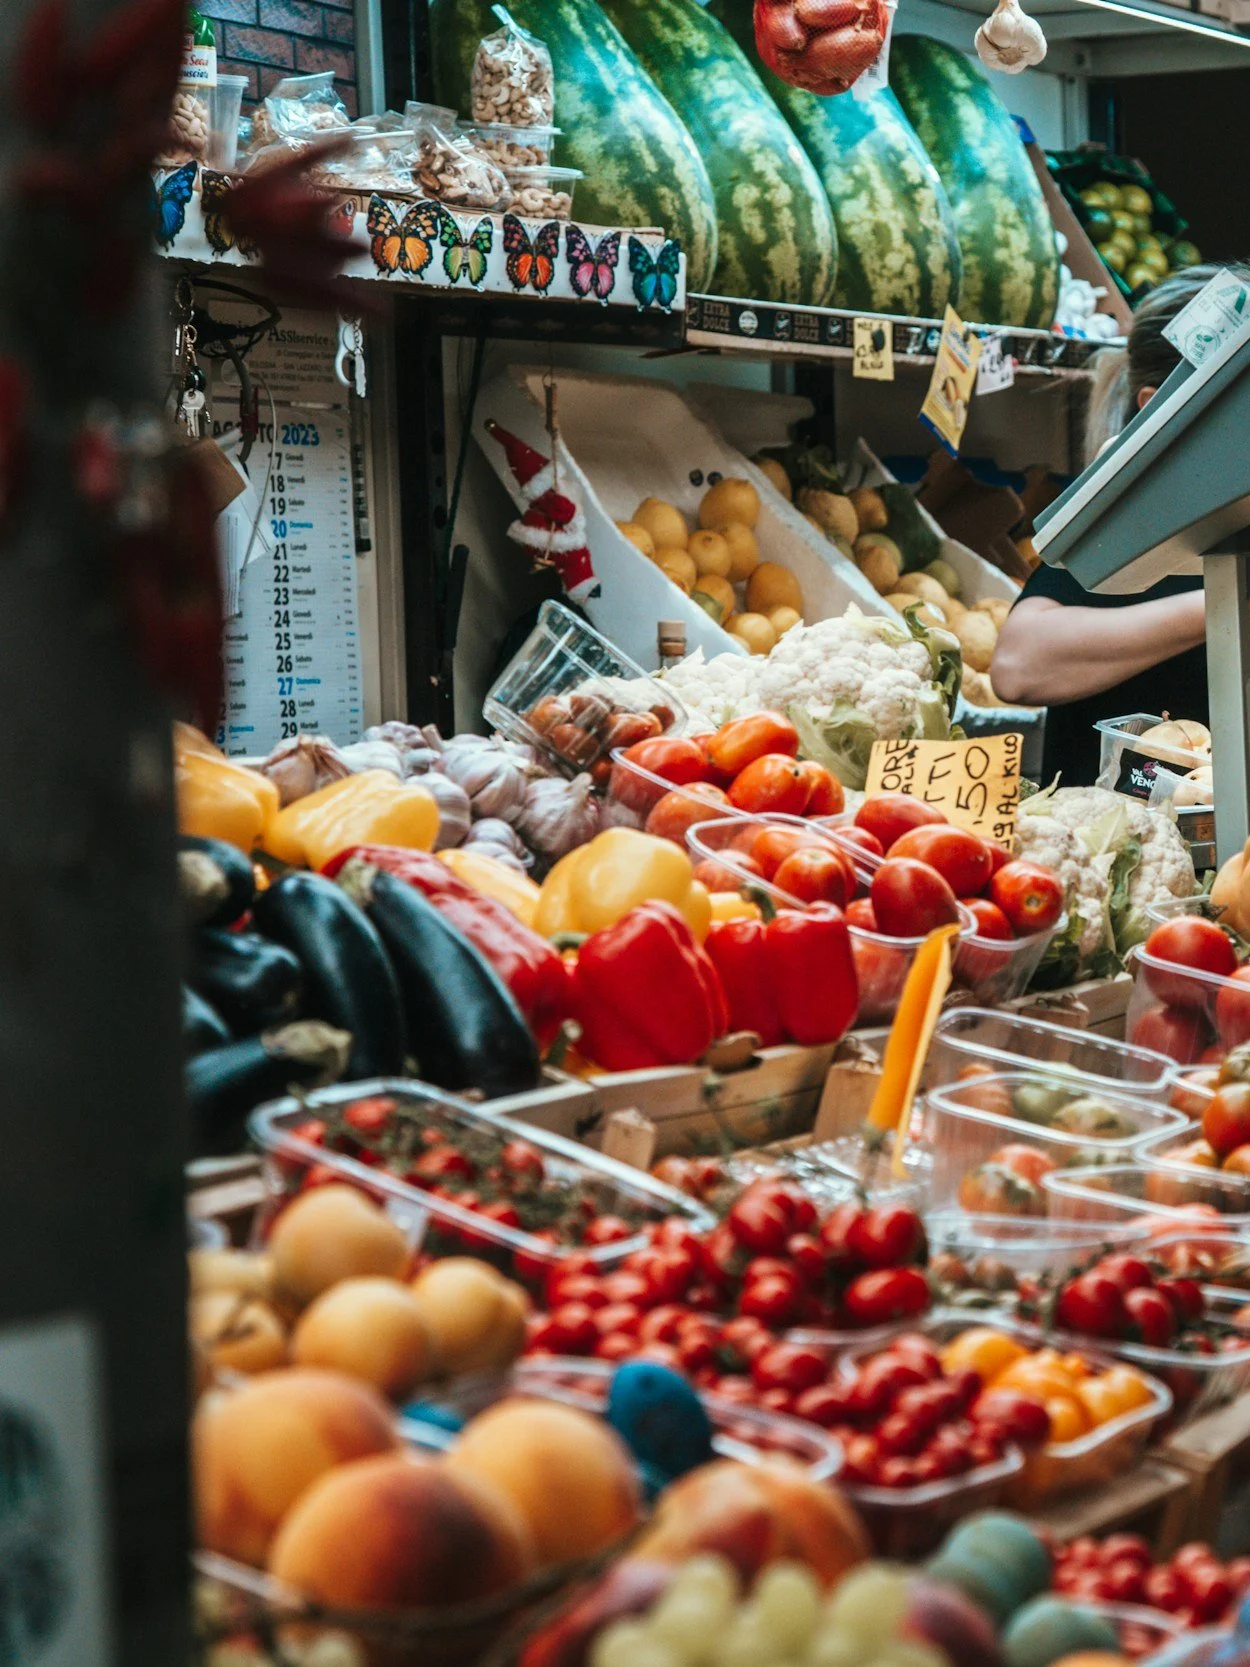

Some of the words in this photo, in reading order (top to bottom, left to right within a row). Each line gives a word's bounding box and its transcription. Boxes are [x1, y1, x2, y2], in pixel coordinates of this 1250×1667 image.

[281, 422, 320, 446] 2023
[270, 474, 285, 493] 18
[270, 497, 286, 516] 19
[270, 519, 288, 539] 20
[273, 565, 289, 583] 22
[273, 587, 290, 605] 23
[274, 610, 291, 628] 24
[275, 632, 292, 651] 25
[276, 655, 293, 674] 26
[277, 676, 294, 696] 27
[280, 699, 297, 719] 28
[281, 721, 298, 740] 29
[1130, 774, 1157, 790] VENO
[1131, 767, 1144, 778] VAL
[996, 784, 1018, 815] AL
